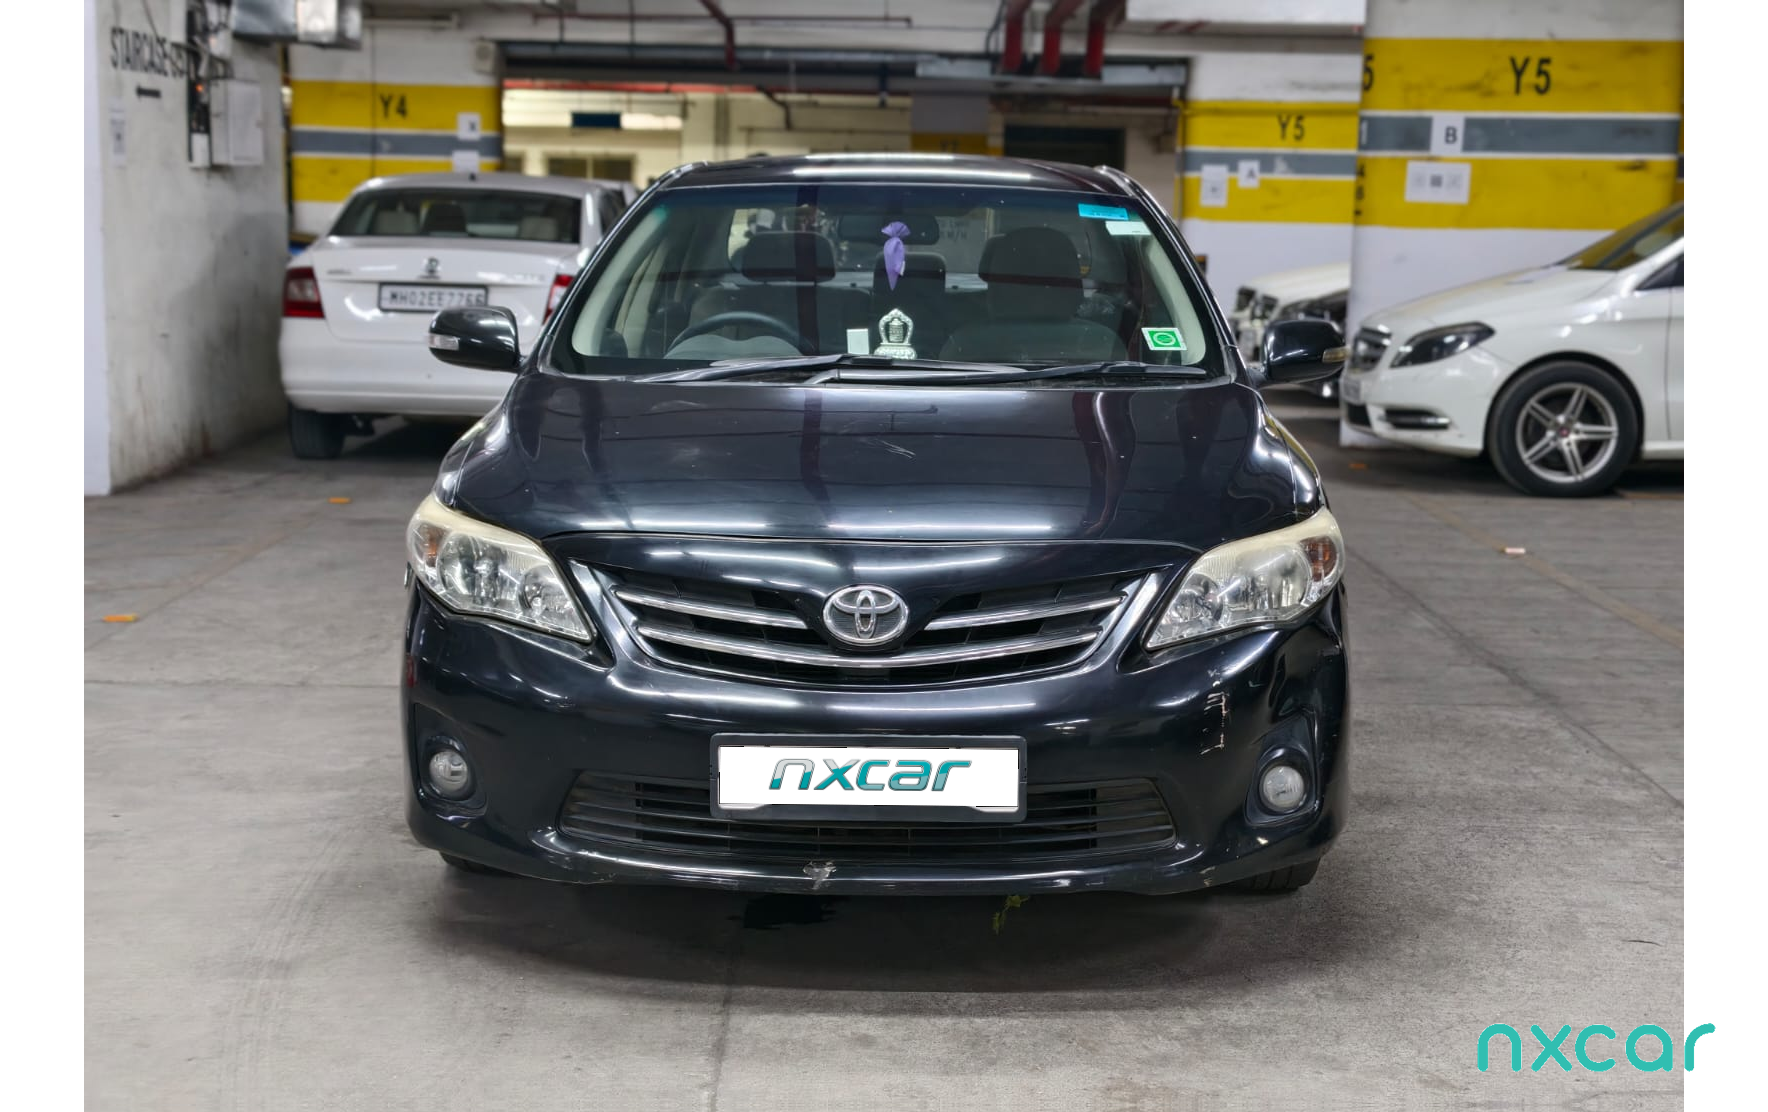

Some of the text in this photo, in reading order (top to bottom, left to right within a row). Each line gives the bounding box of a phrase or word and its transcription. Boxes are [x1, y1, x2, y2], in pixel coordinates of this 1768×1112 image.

[1509, 56, 1552, 95] Y5
[379, 93, 407, 119] Y4
[1277, 114, 1305, 141] Y5
[1444, 126, 1458, 145] B
